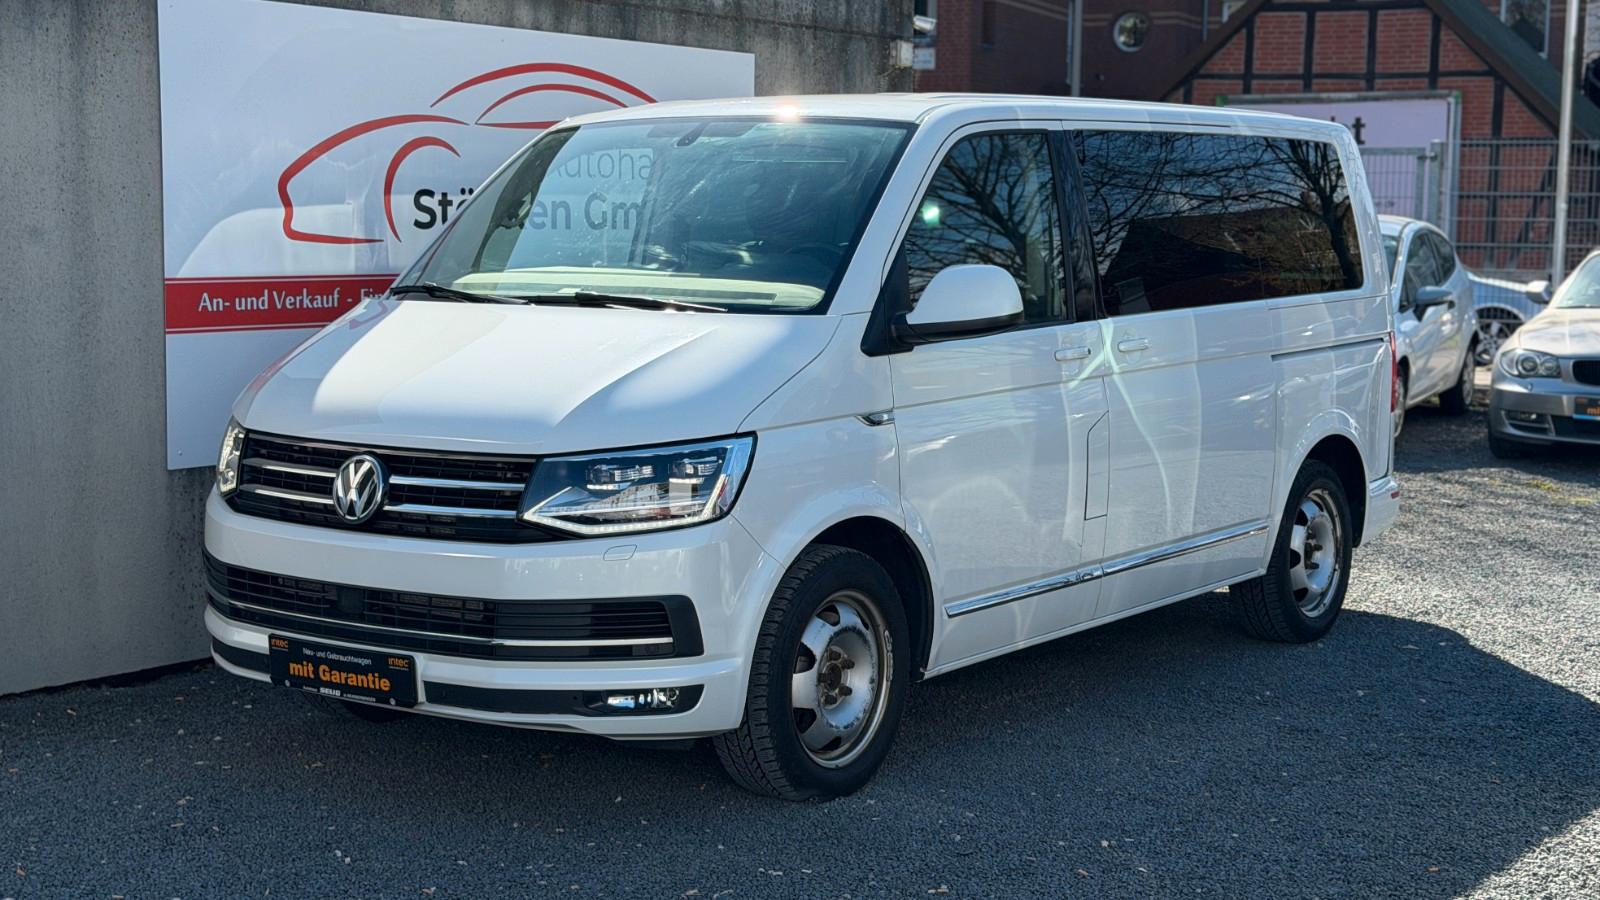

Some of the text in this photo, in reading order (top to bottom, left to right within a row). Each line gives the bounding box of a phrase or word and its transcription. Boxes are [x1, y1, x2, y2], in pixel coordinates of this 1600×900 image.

[198, 292, 230, 312] An-
[235, 289, 269, 311] und
[273, 287, 340, 310] Verkauf
[388, 657, 409, 667] intec
[289, 662, 391, 692] mit Garantie
